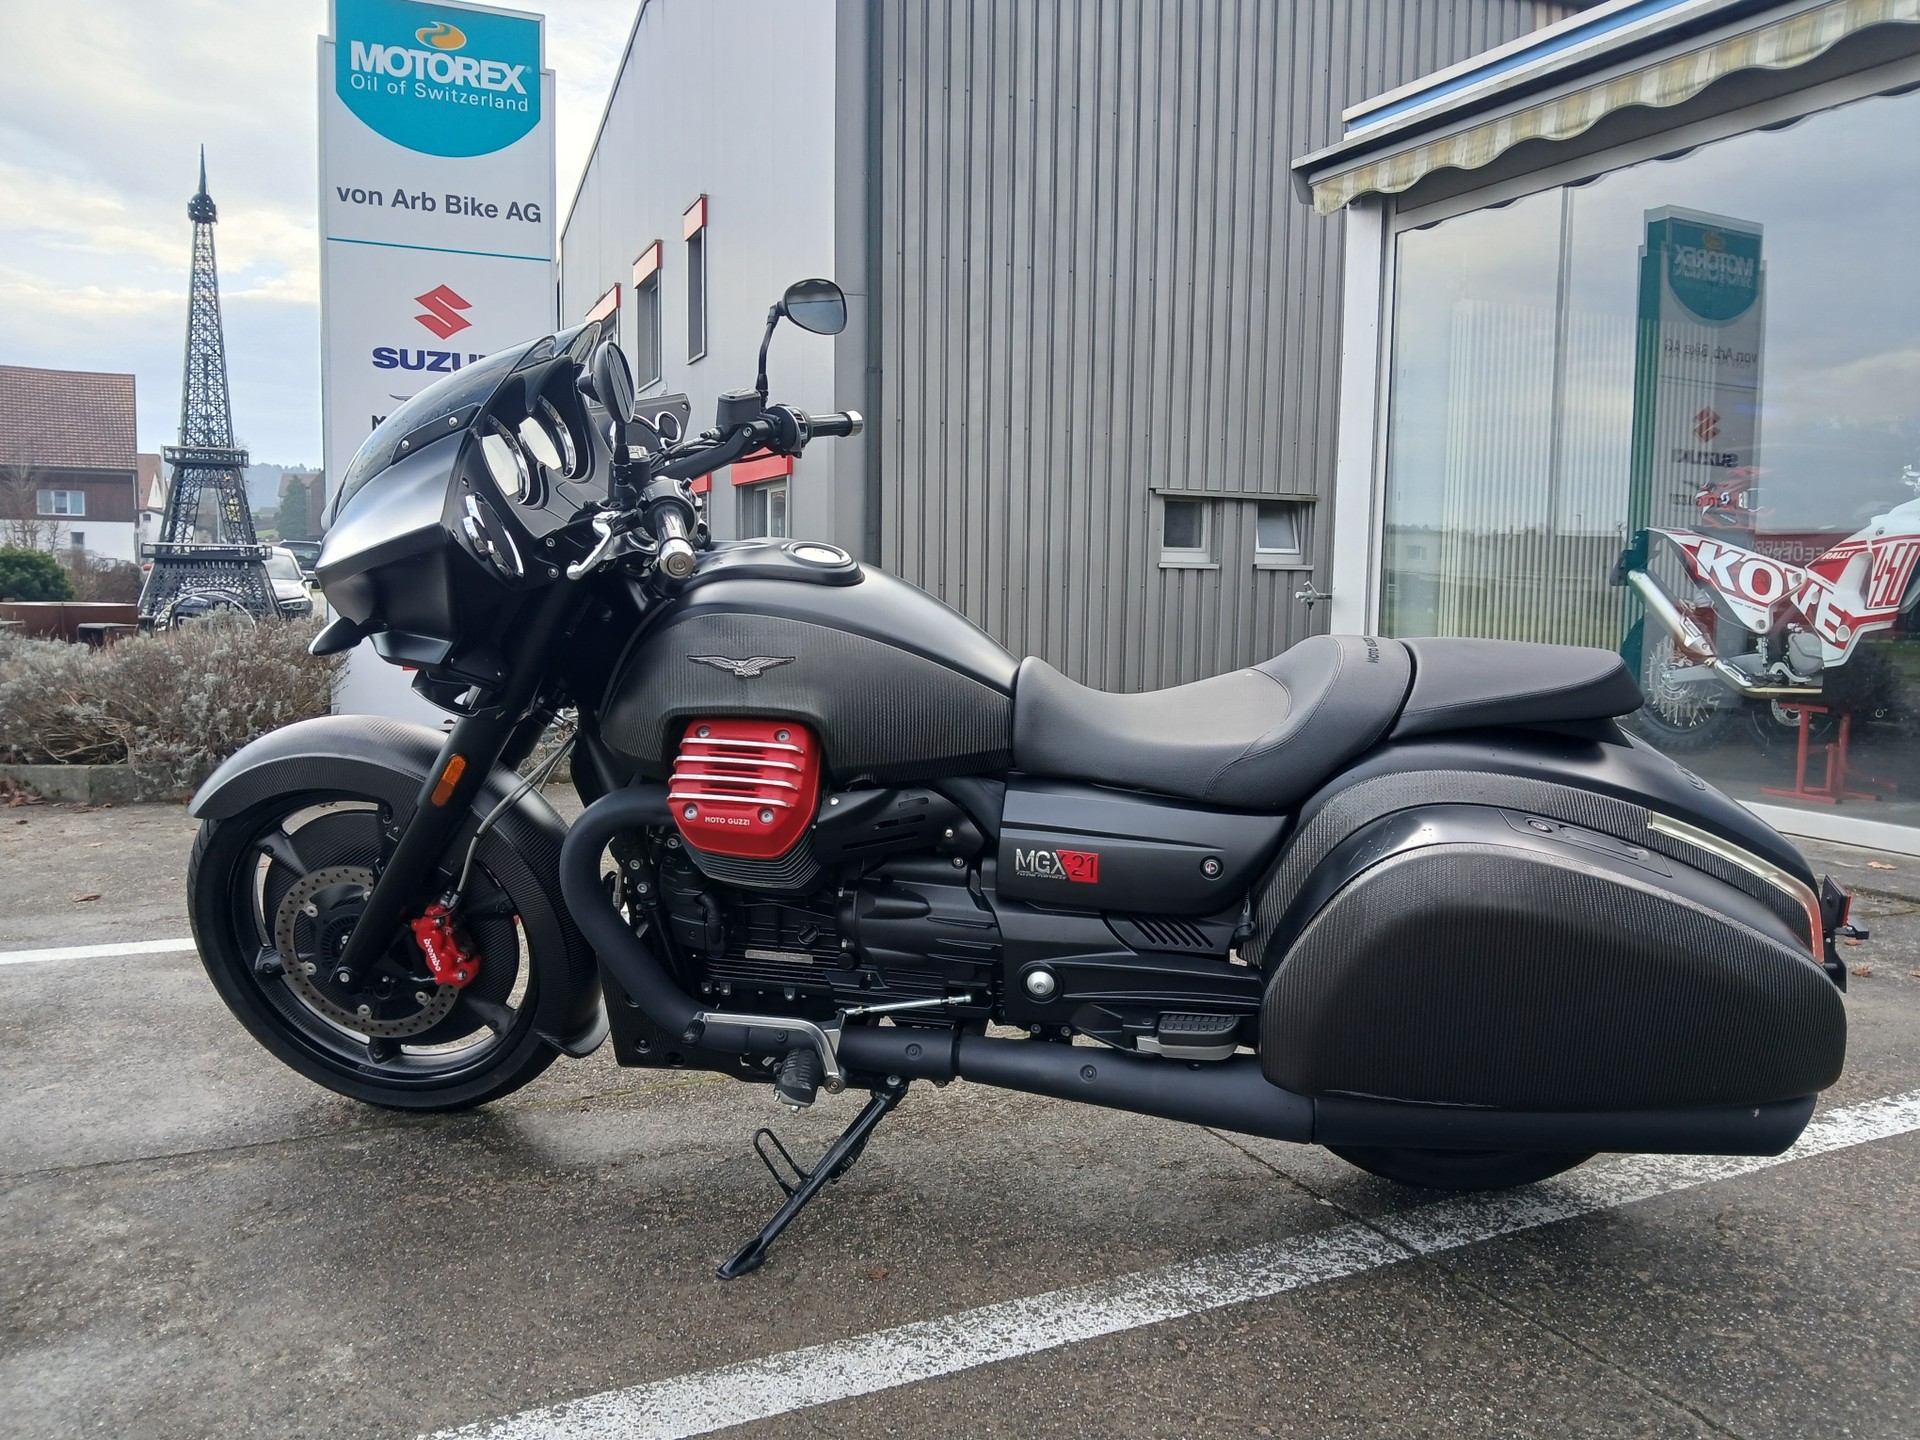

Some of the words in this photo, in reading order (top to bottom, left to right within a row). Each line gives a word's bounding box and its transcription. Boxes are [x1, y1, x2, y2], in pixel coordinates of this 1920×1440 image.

[350, 40, 527, 95] MOTOREX
[350, 73, 378, 92] Oil
[387, 80, 407, 95] of
[414, 83, 529, 112] Switzerland
[336, 186, 383, 206] von
[391, 188, 437, 212] Arb
[445, 194, 499, 219] Bike
[506, 201, 542, 223] AG
[372, 347, 487, 373] SUZU
[1822, 550, 1854, 561] RALLY
[704, 816, 726, 825] MOTO
[727, 817, 750, 826] GUZZI
[423, 938, 441, 971] brembo
